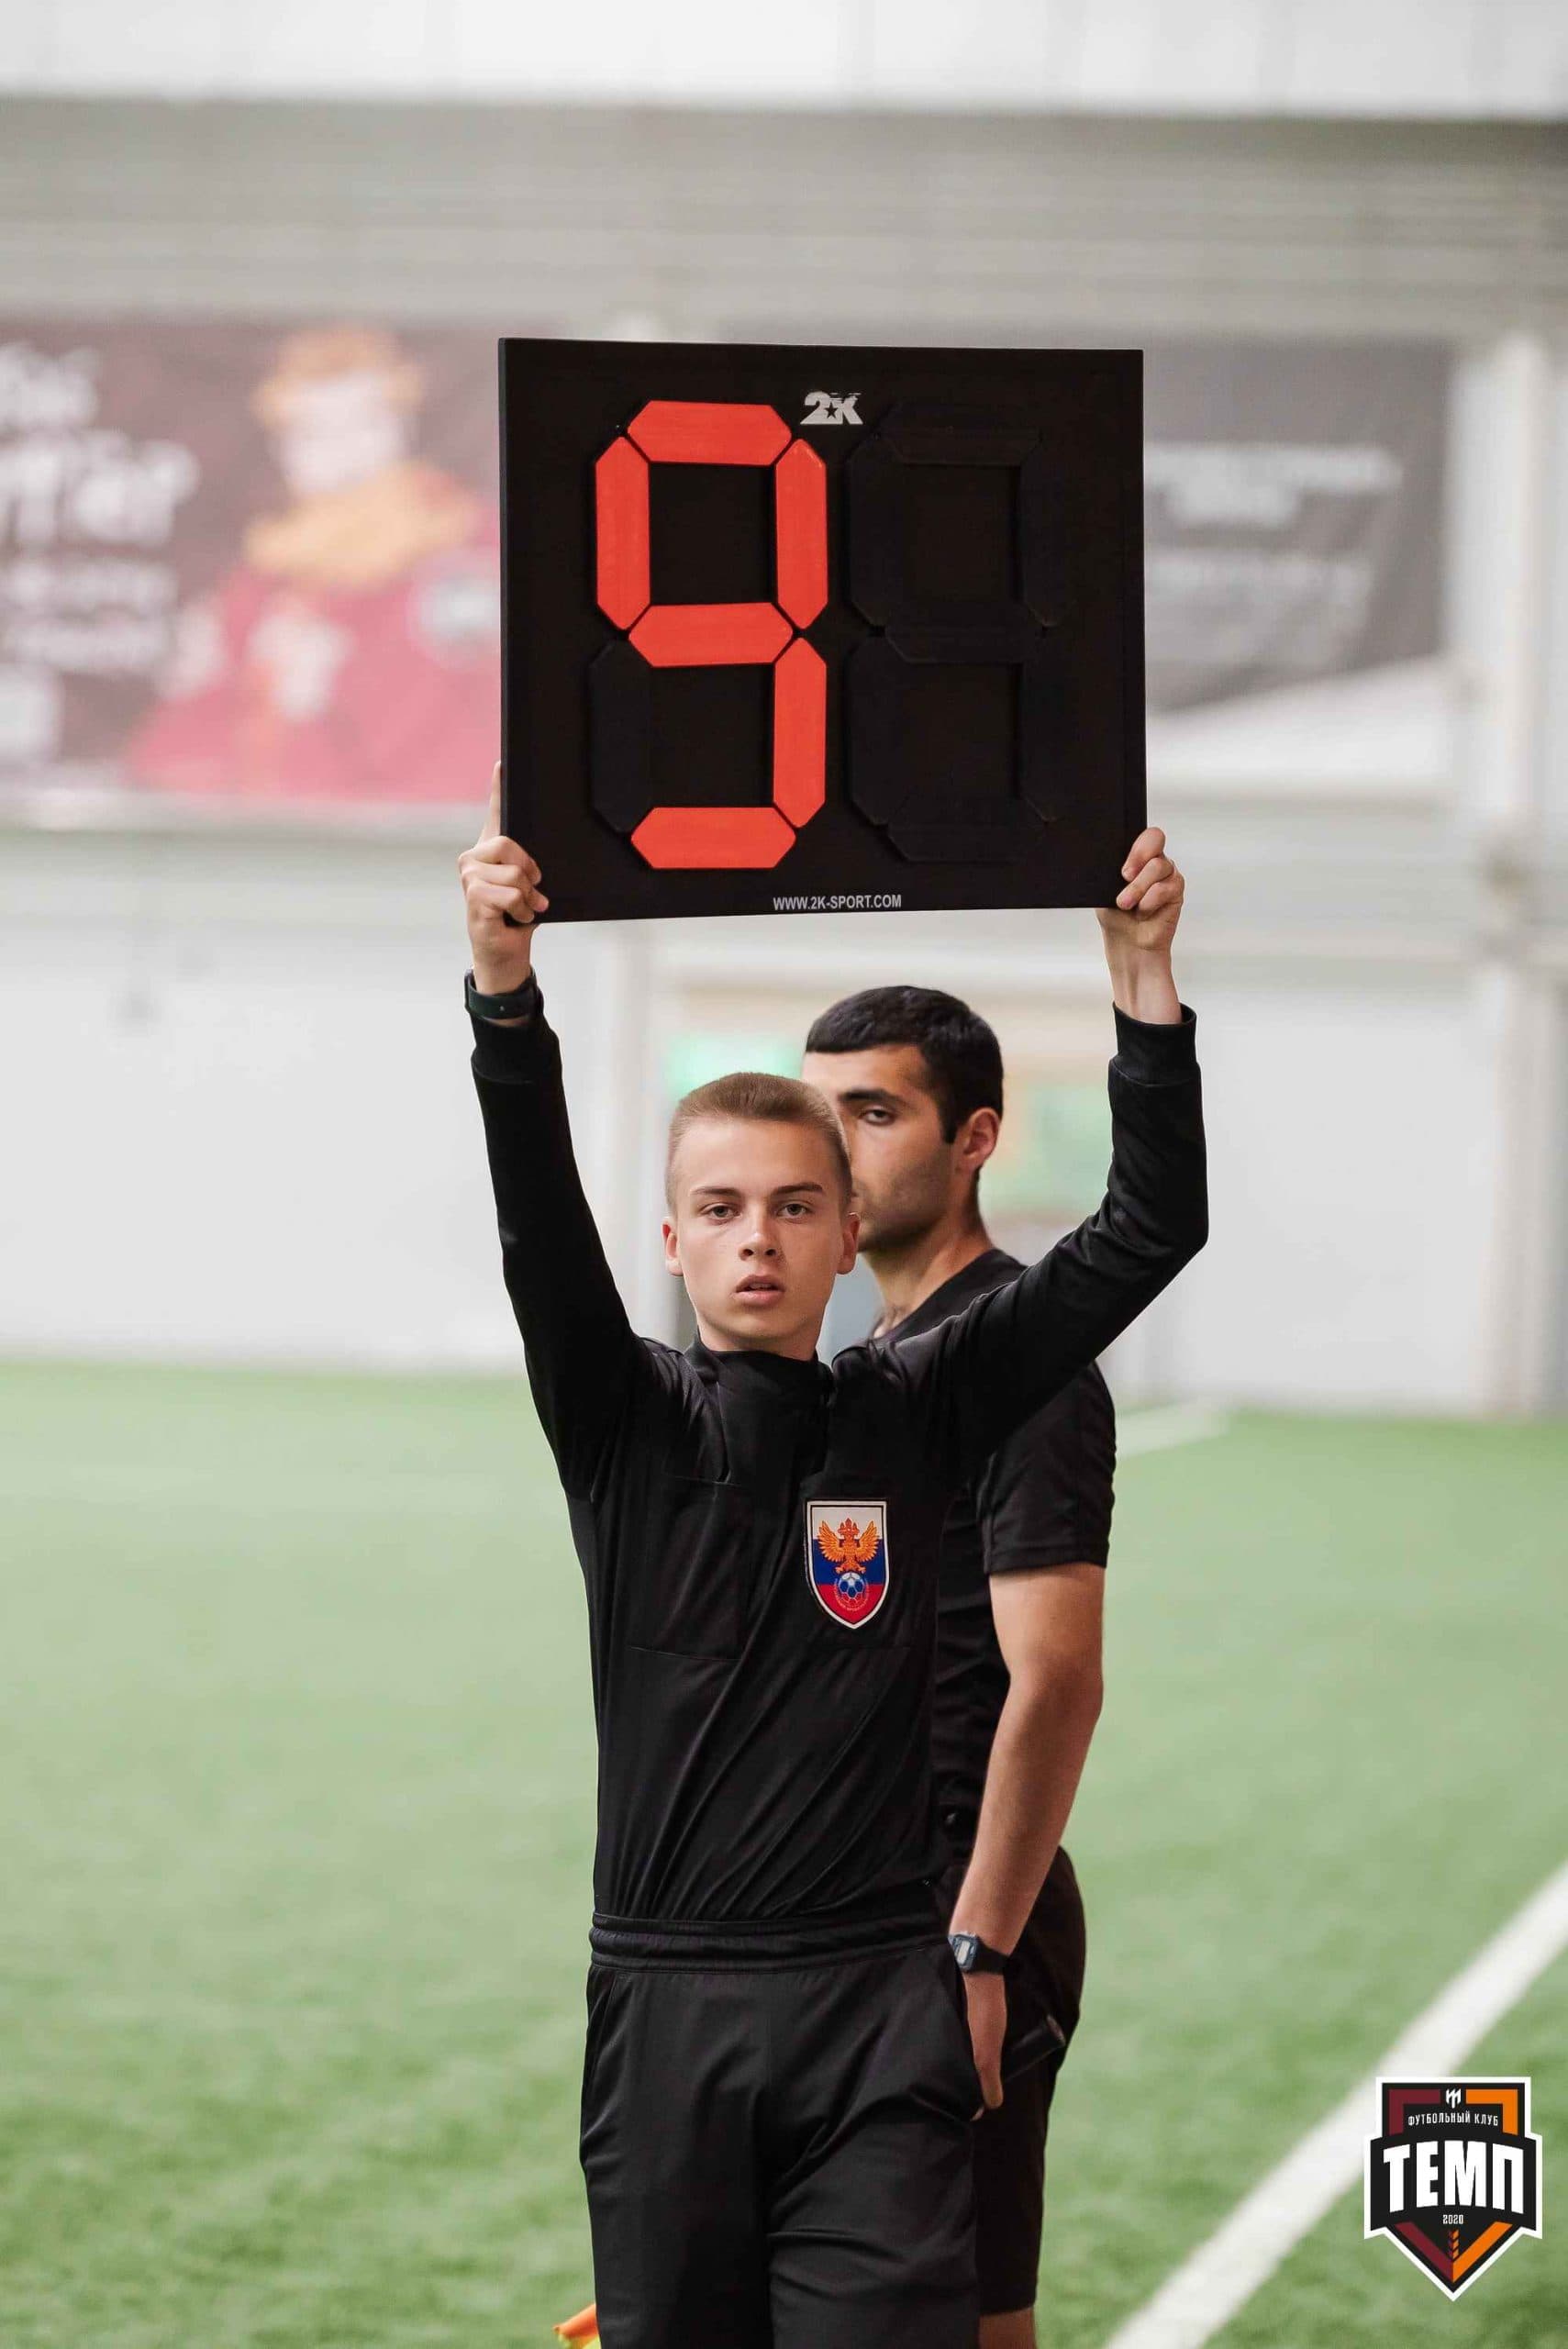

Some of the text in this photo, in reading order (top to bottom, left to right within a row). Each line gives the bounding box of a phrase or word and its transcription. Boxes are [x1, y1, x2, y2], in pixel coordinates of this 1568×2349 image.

[800, 391, 863, 425] 2K
[595, 400, 828, 869] 9
[773, 894, 903, 911] WWW.2K-SPORT.COM
